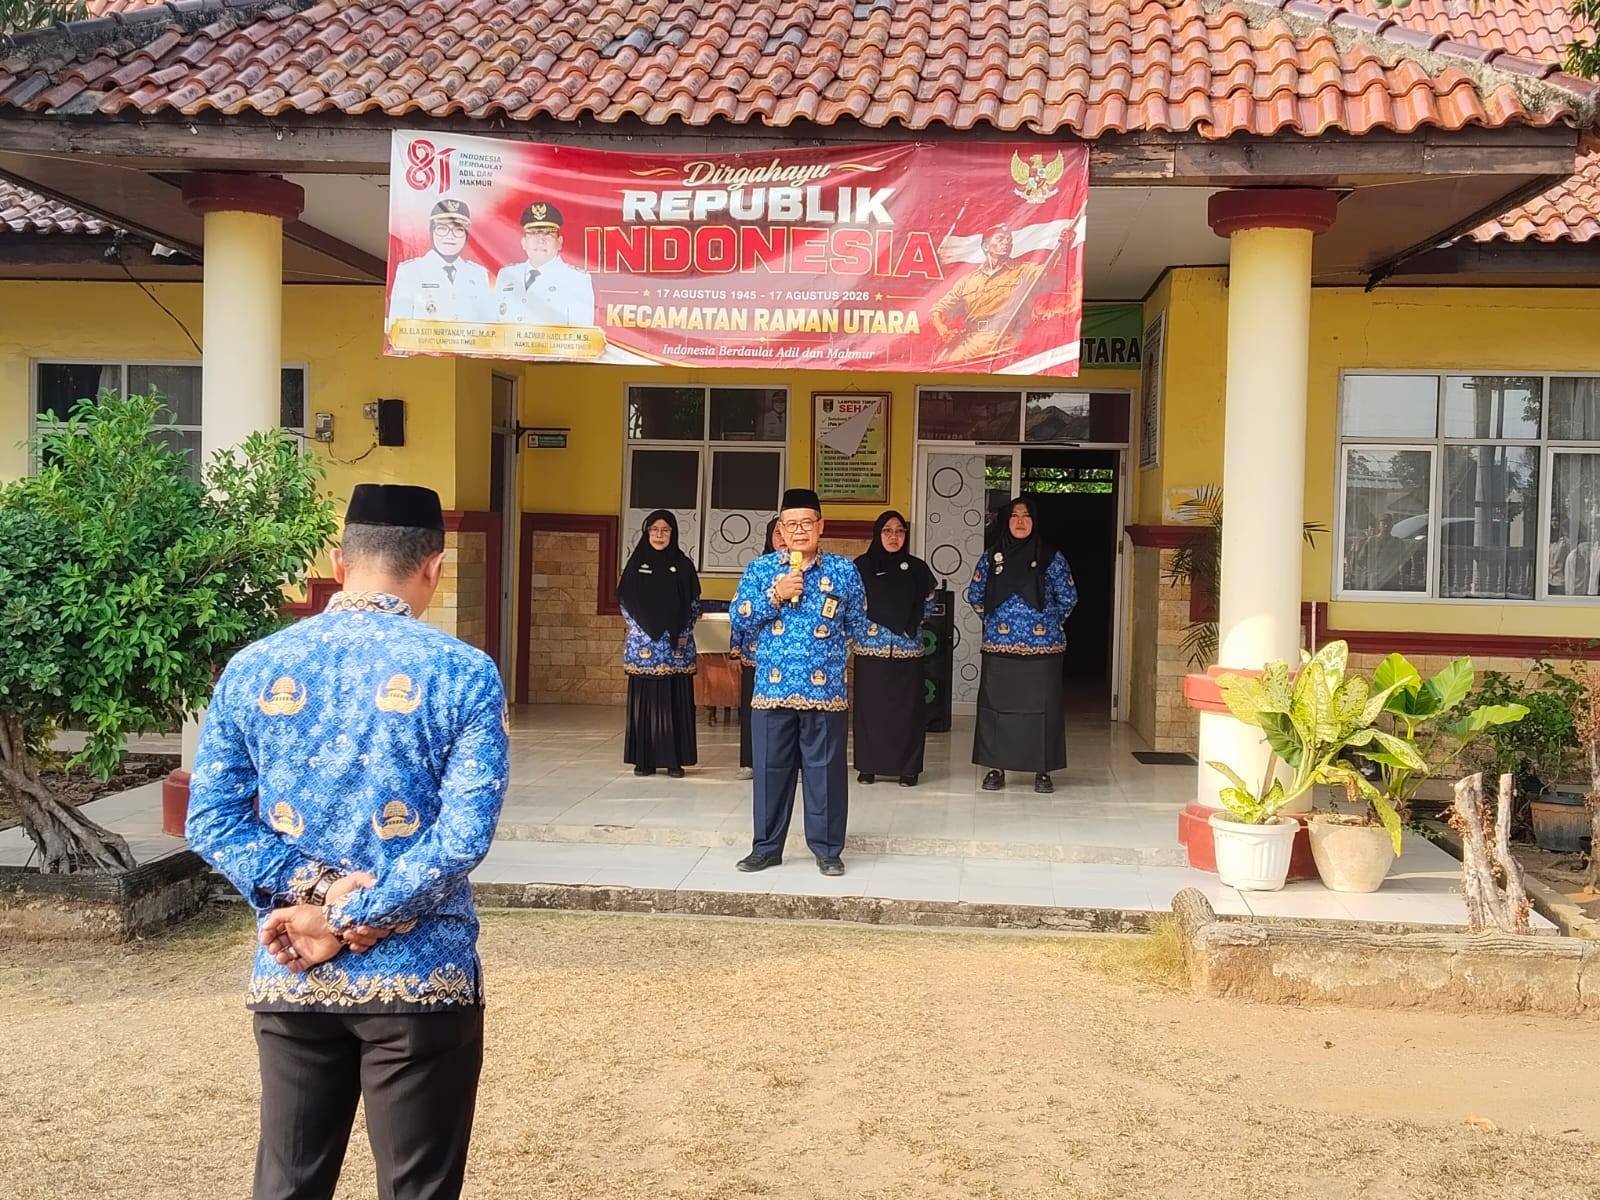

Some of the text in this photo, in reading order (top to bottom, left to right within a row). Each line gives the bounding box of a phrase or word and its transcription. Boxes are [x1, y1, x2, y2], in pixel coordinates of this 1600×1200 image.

[460, 152, 502, 163] INDONESIA
[459, 160, 503, 170] BERDAULAT
[459, 170, 493, 178] ADIL DAN
[682, 158, 833, 191] Dirgahayu
[459, 179, 492, 187] MAKMUR
[620, 185, 896, 225] REPUBLIK
[584, 225, 944, 280] INDONESIA
[657, 289, 671, 299] 17
[672, 289, 727, 300] AGUSTUS
[730, 290, 757, 300] 1945
[769, 290, 783, 301] 17
[785, 291, 841, 301] AGUSTUS
[842, 291, 870, 302] 2026
[606, 304, 921, 335] KECAMATAN RAMAN UTARA
[662, 344, 875, 360] Indonesia Berdaulat Adil dan Makmur
